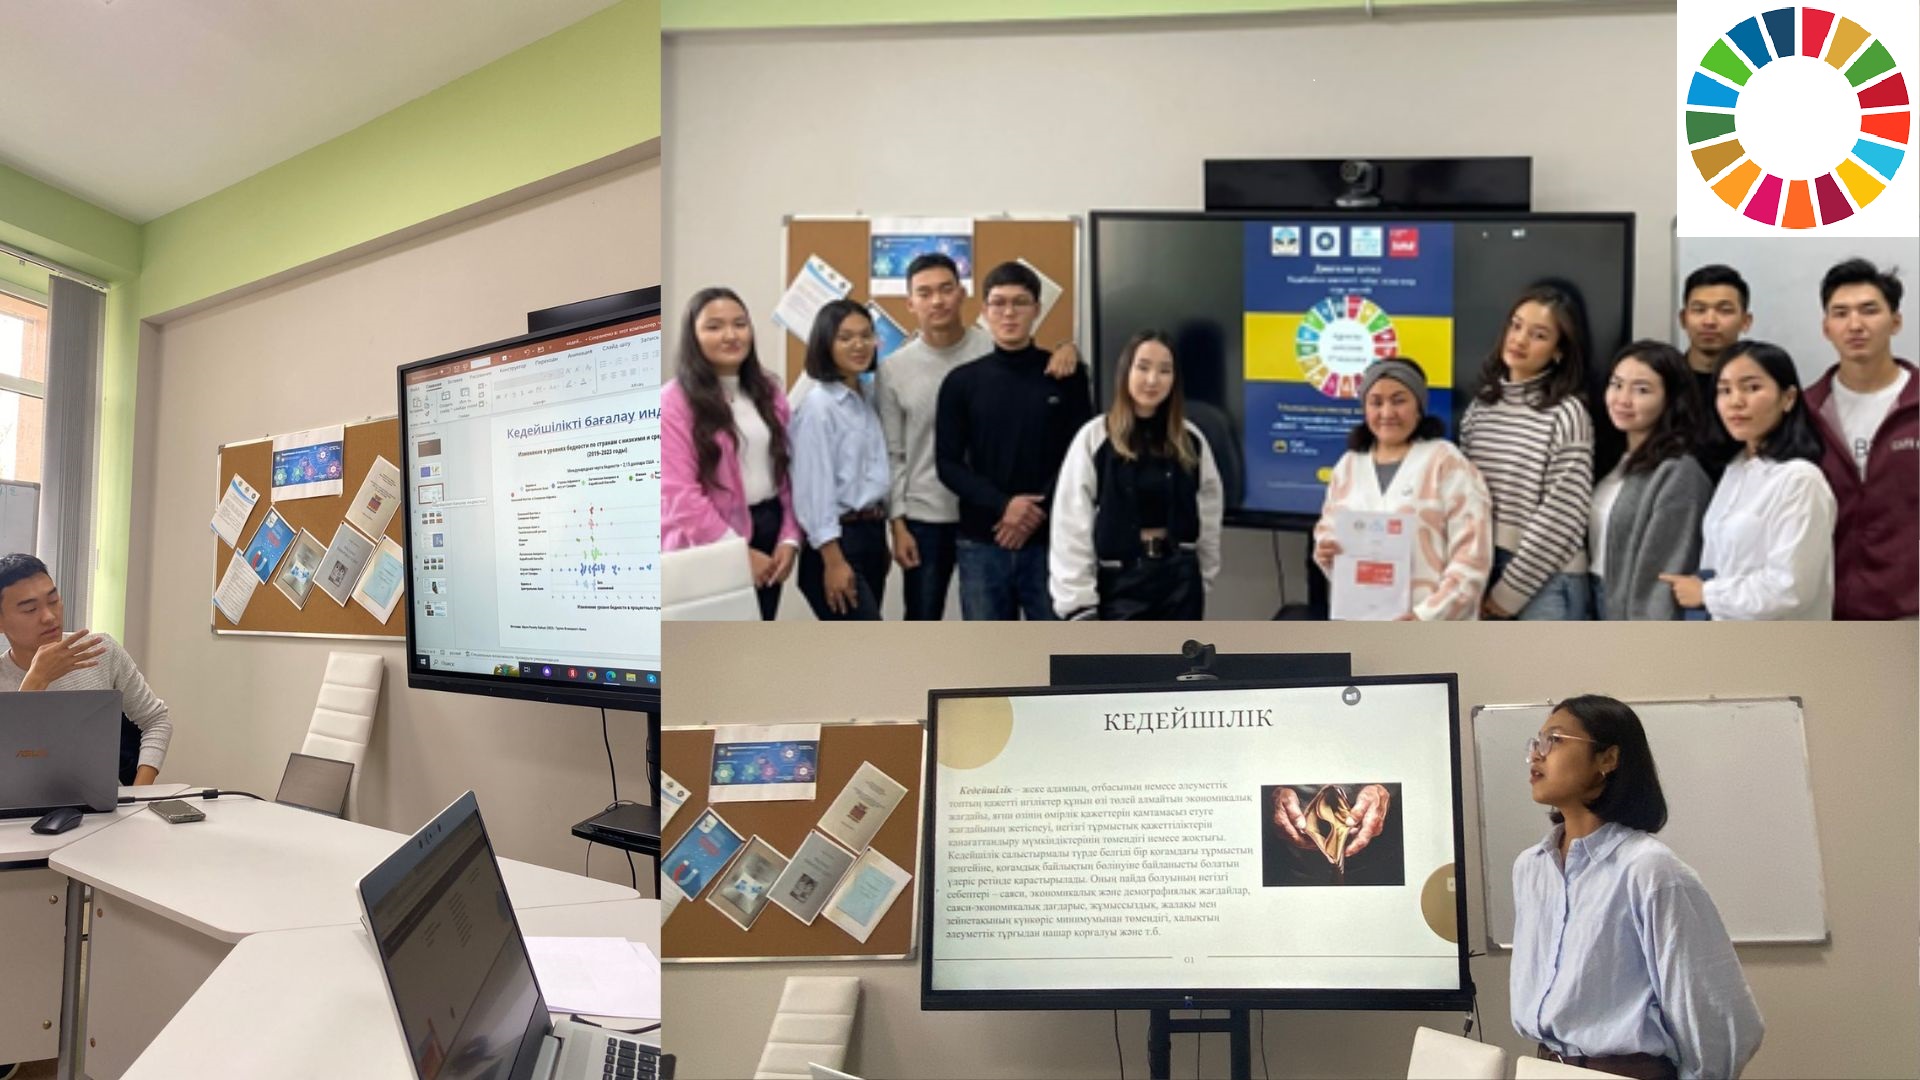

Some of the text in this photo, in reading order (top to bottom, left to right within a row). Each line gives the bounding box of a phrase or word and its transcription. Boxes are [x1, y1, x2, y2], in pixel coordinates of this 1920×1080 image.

[507, 418, 582, 440] Кедейшілікті
[585, 411, 635, 427] бағалау
[566, 443, 589, 451] бедности
[597, 440, 617, 448] странам
[651, 434, 661, 442] сре
[1104, 706, 1274, 734] КЕДЕЙШІЛІК
